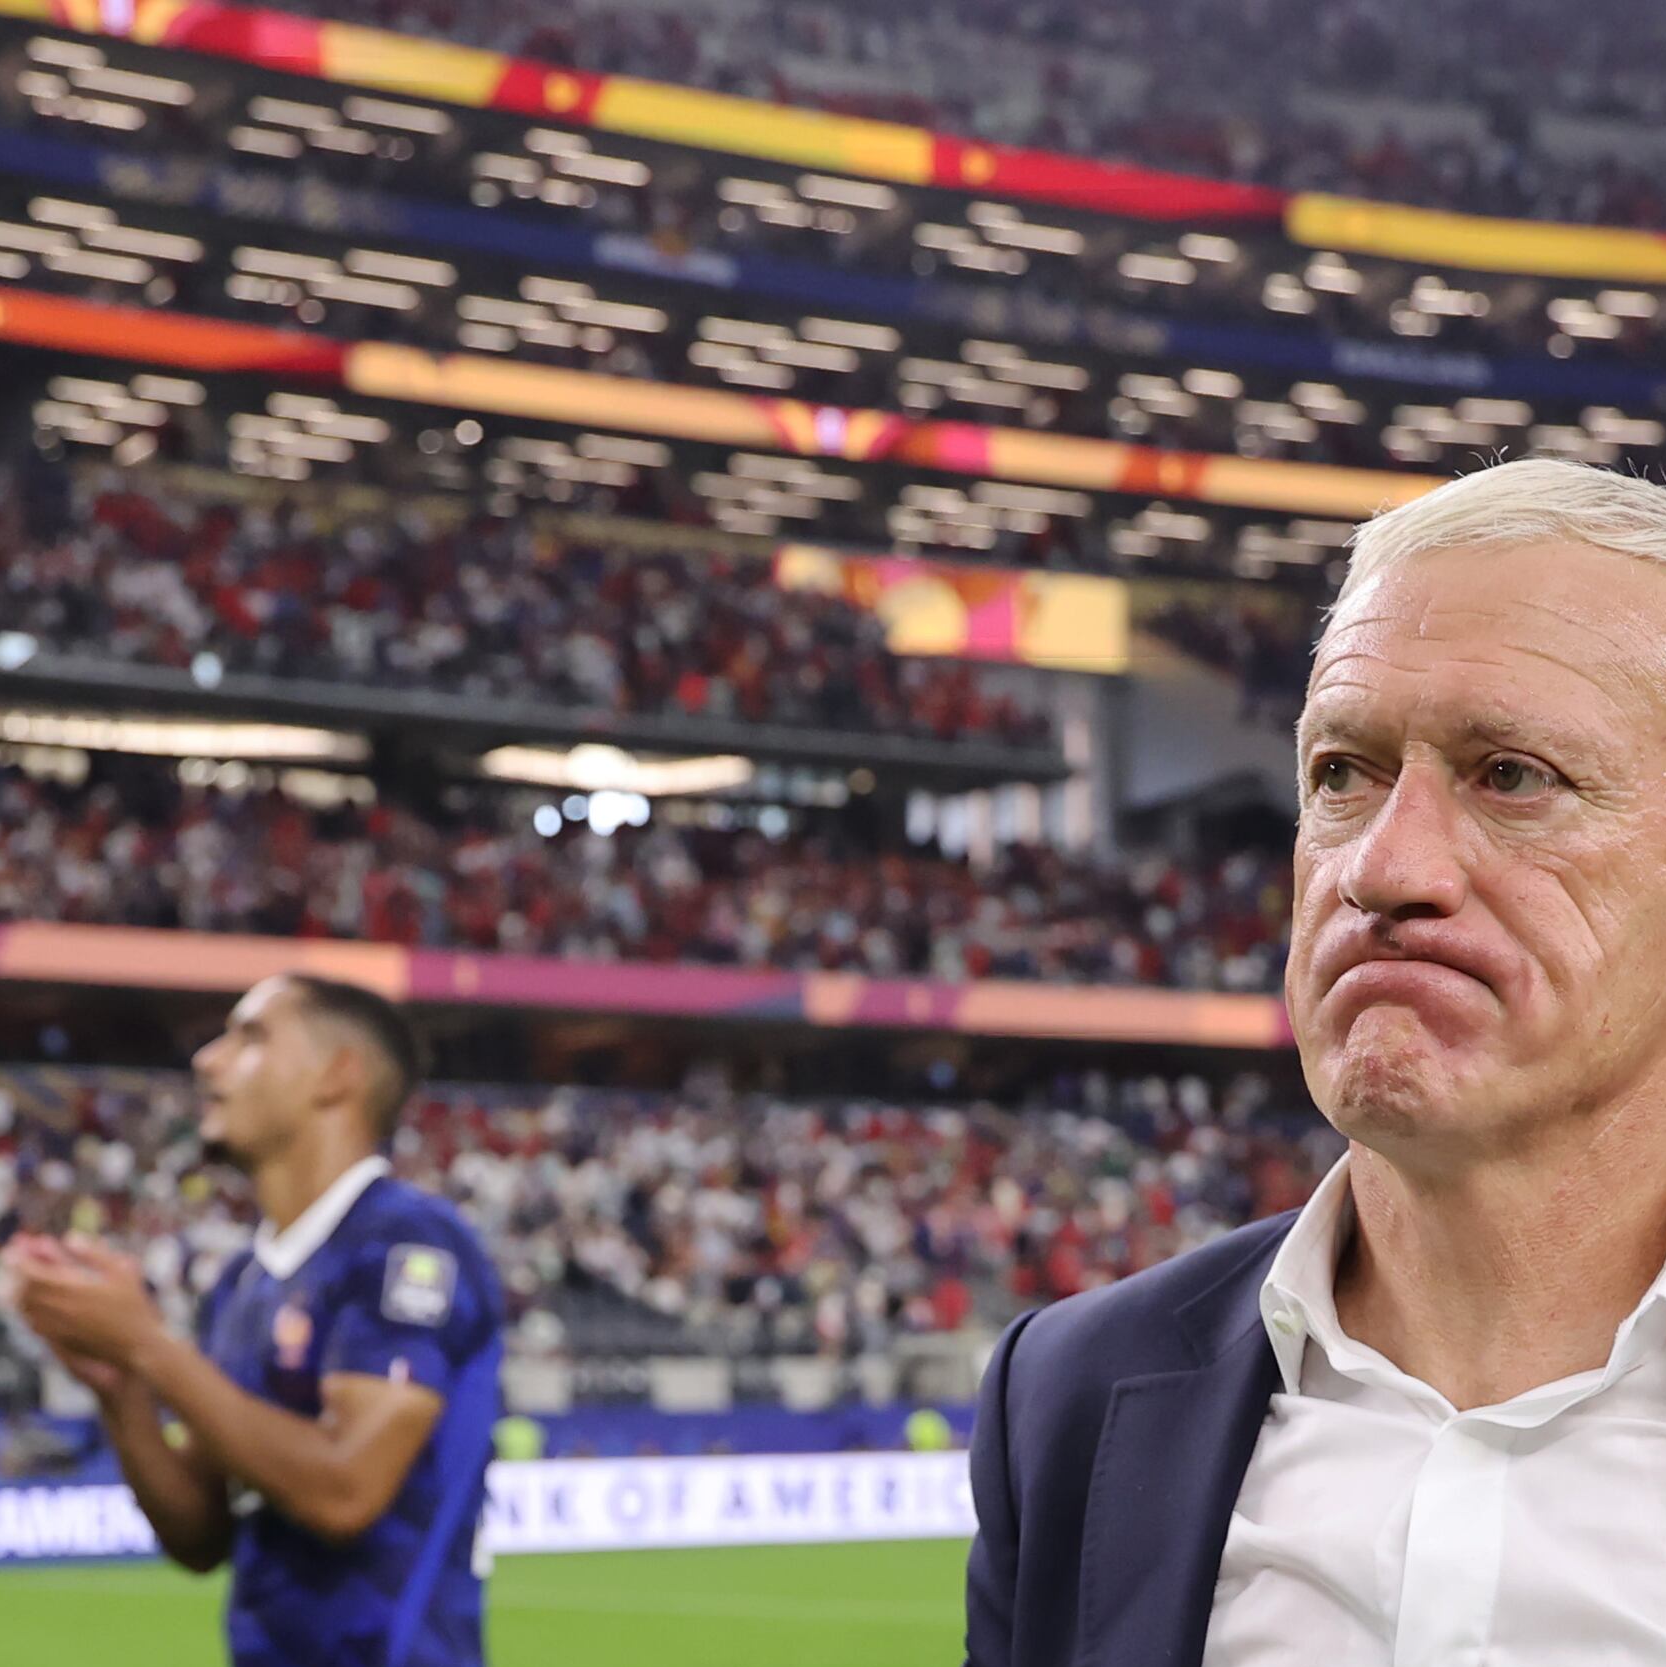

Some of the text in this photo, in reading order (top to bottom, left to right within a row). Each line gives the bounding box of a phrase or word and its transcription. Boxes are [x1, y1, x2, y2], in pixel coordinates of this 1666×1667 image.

[489, 1470, 974, 1527] NK OF AMERIC
